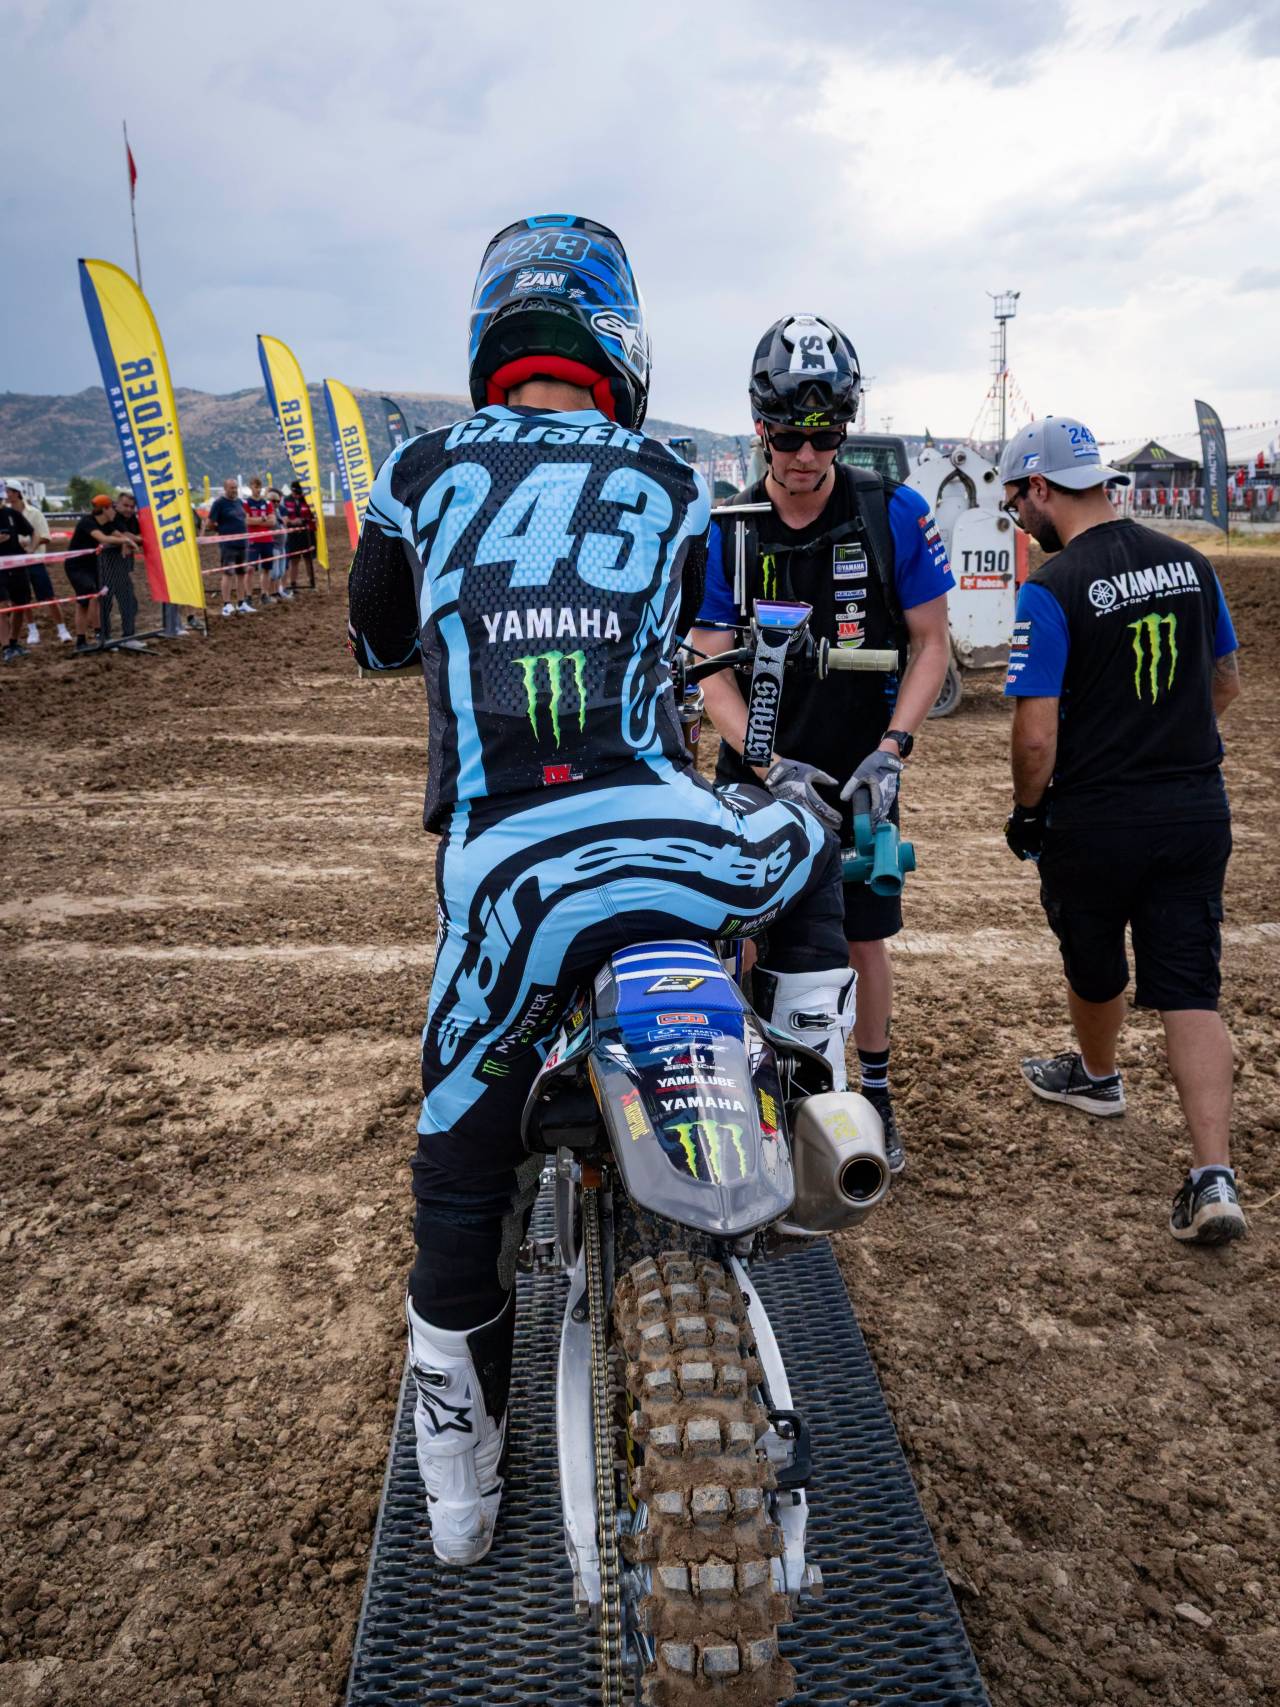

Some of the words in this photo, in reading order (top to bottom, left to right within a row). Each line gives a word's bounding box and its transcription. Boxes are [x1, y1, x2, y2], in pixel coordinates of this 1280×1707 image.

[502, 232, 591, 268] 243
[444, 417, 645, 453] GAJSER
[1208, 440, 1218, 487] PRACTICE
[415, 461, 674, 612] 243
[841, 563, 865, 571] YAMAHA
[962, 550, 1010, 573] T190
[1111, 561, 1200, 600] YAMAHA
[1095, 594, 1151, 617] FACTORY
[1155, 586, 1202, 598] RACING
[481, 607, 622, 644] YAMAHA
[495, 991, 555, 1054] MONSTER
[657, 1074, 737, 1088] YAMALUBE
[660, 1096, 746, 1112] YAMAHA
